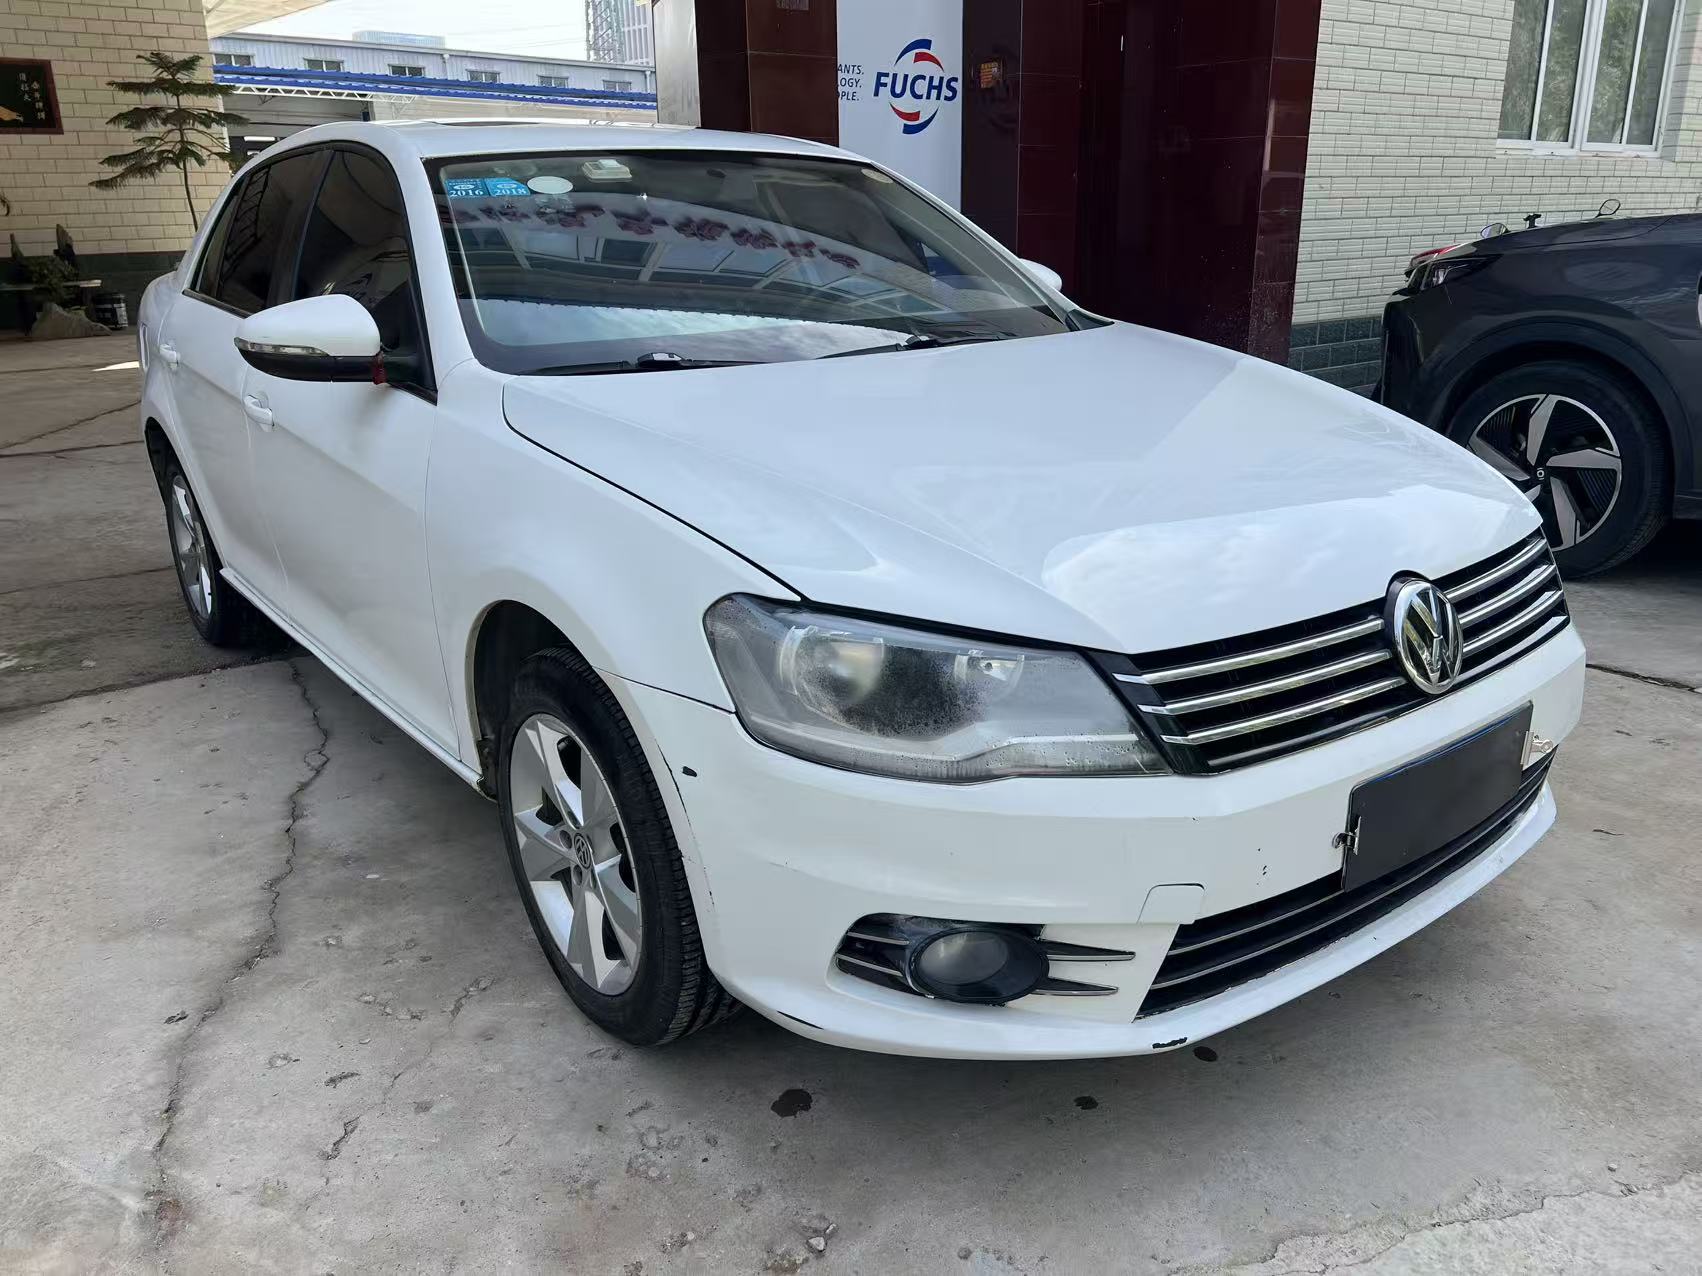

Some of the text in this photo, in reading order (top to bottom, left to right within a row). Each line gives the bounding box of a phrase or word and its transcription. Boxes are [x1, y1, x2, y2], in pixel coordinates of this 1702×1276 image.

[837, 77, 862, 89] OGY.
[873, 72, 958, 101] FUCHS
[449, 189, 484, 197] 2016
[495, 188, 526, 196] 2018
